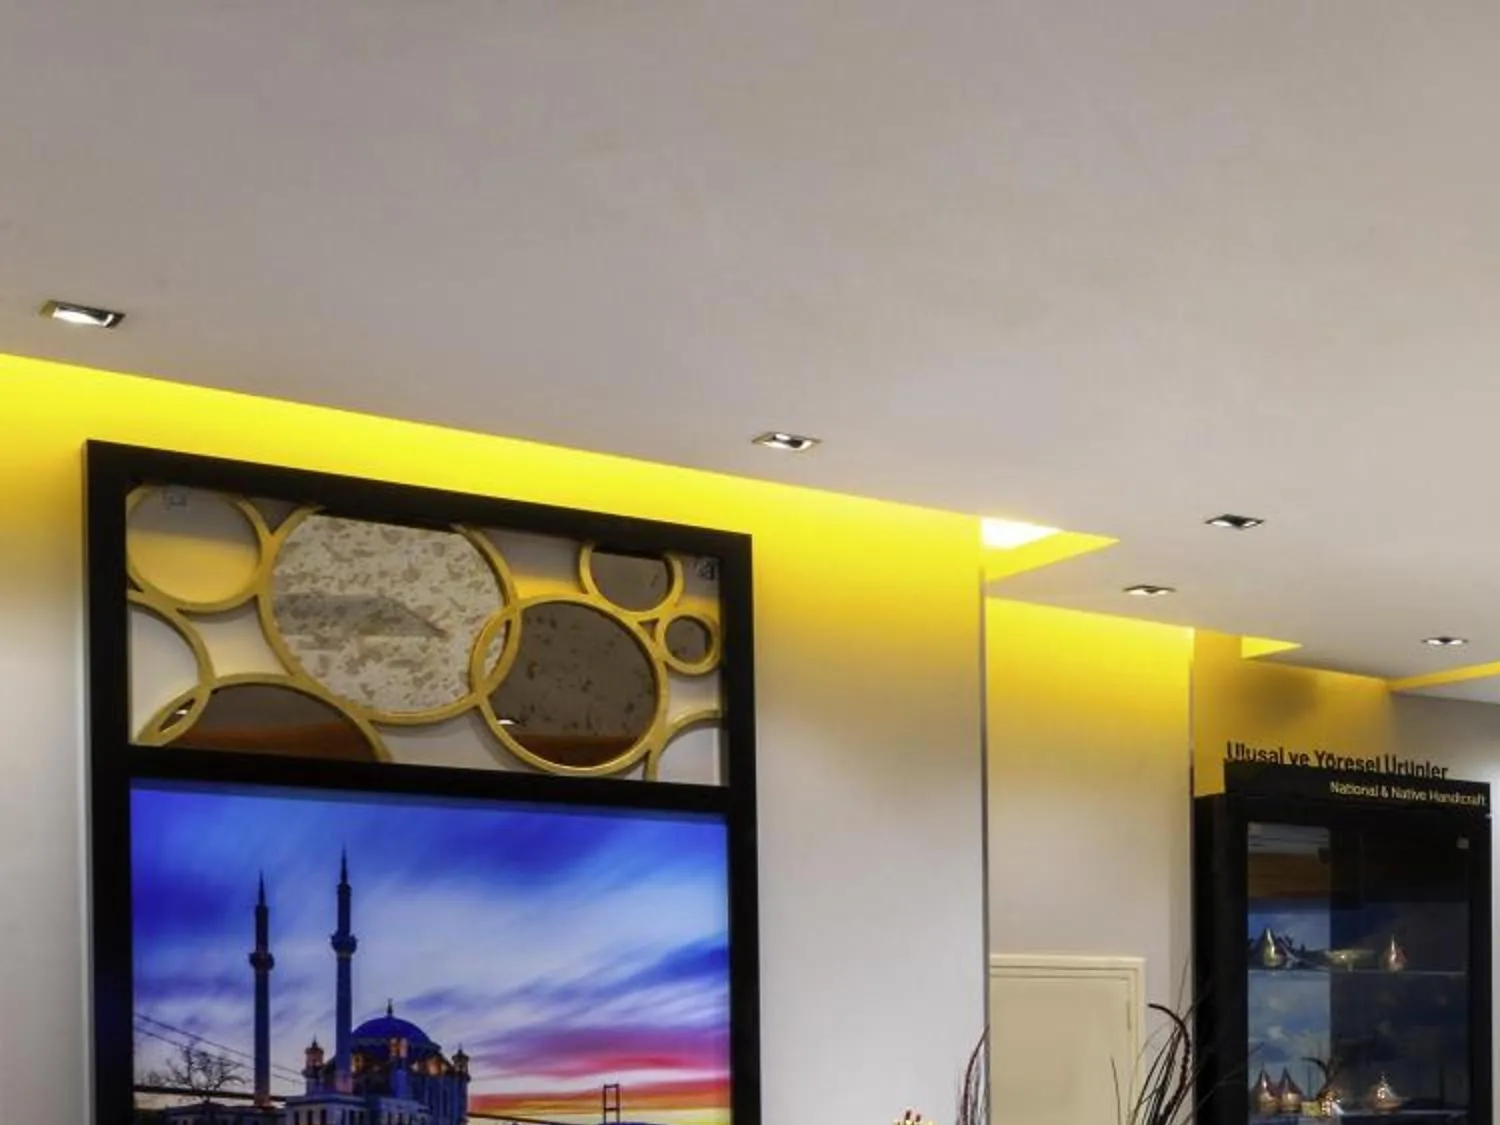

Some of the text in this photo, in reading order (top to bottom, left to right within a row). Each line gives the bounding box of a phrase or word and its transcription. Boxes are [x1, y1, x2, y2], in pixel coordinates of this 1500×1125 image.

[1226, 741, 1285, 766] Ulusal
[1287, 751, 1310, 768] ve
[1329, 780, 1379, 798] National
[1381, 785, 1389, 799] &
[1391, 785, 1427, 801] Native
